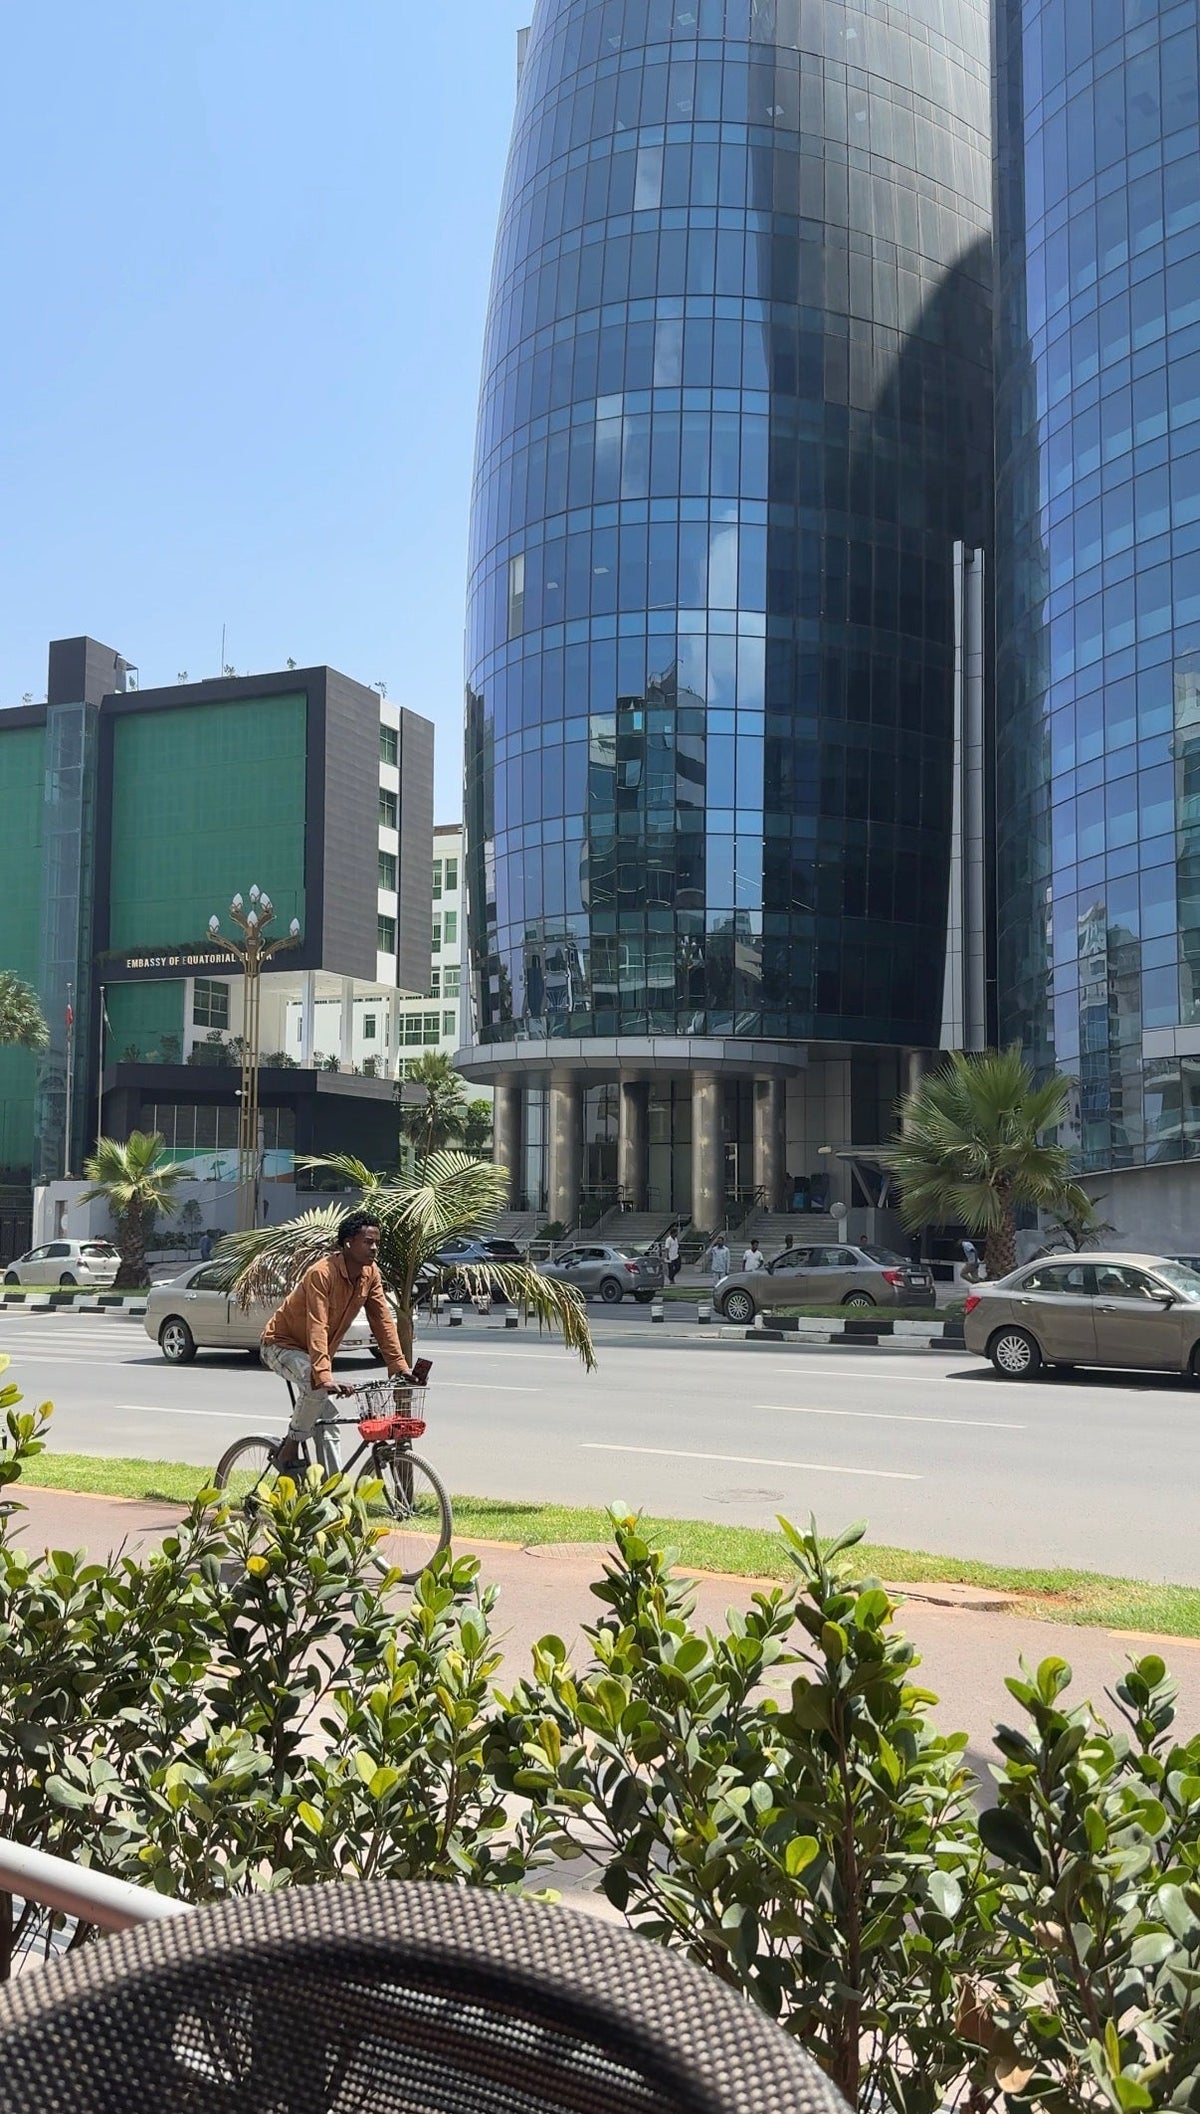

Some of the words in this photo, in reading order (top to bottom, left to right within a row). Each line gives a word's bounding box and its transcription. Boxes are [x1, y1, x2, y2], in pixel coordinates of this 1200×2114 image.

[127, 957, 166, 968] EMBASSY
[169, 956, 180, 966] OF
[182, 953, 237, 965] EQUATORIAL
